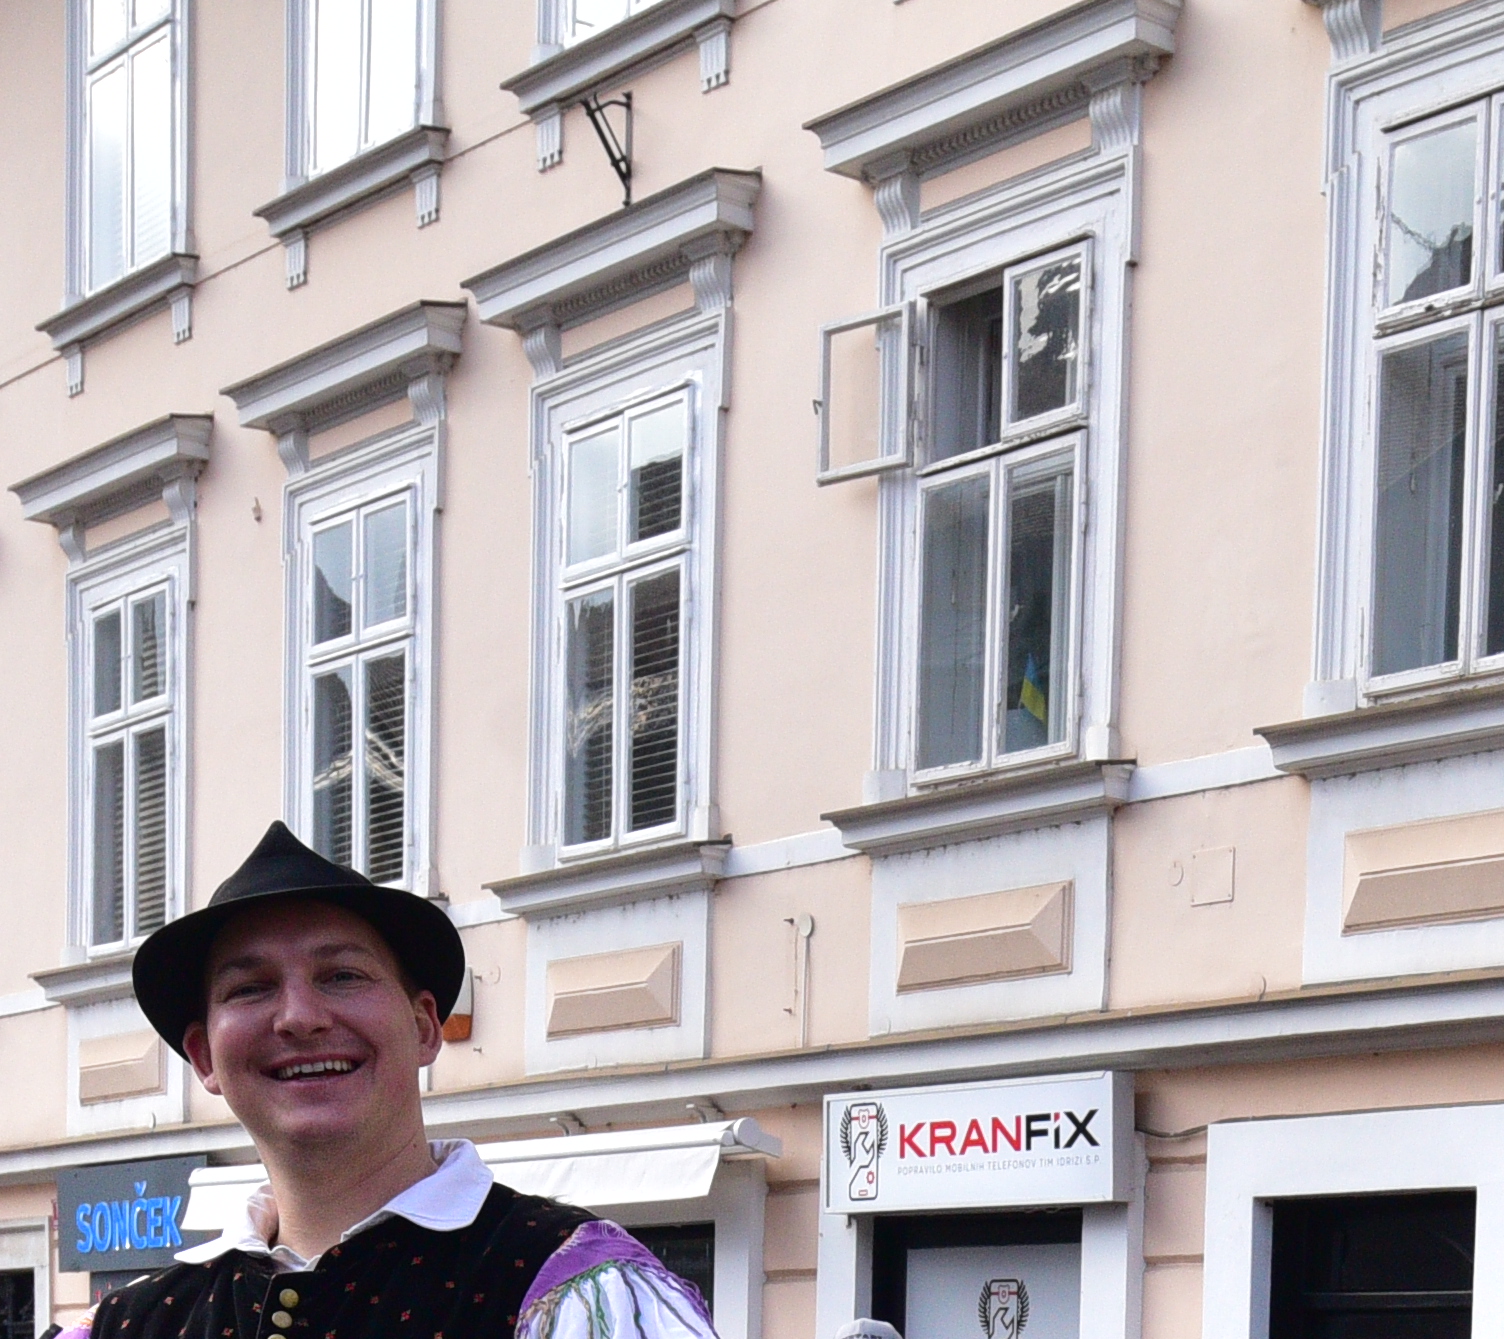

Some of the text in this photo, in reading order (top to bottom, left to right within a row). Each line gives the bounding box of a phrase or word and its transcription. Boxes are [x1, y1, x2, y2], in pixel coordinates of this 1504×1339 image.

[897, 1164, 943, 1176] POPRAVILO
[945, 1161, 985, 1173] MOBILNIH
[987, 1159, 1037, 1171] TELEFONOV
[1039, 1158, 1054, 1168] TIM
[75, 1180, 182, 1254] SONČEK
